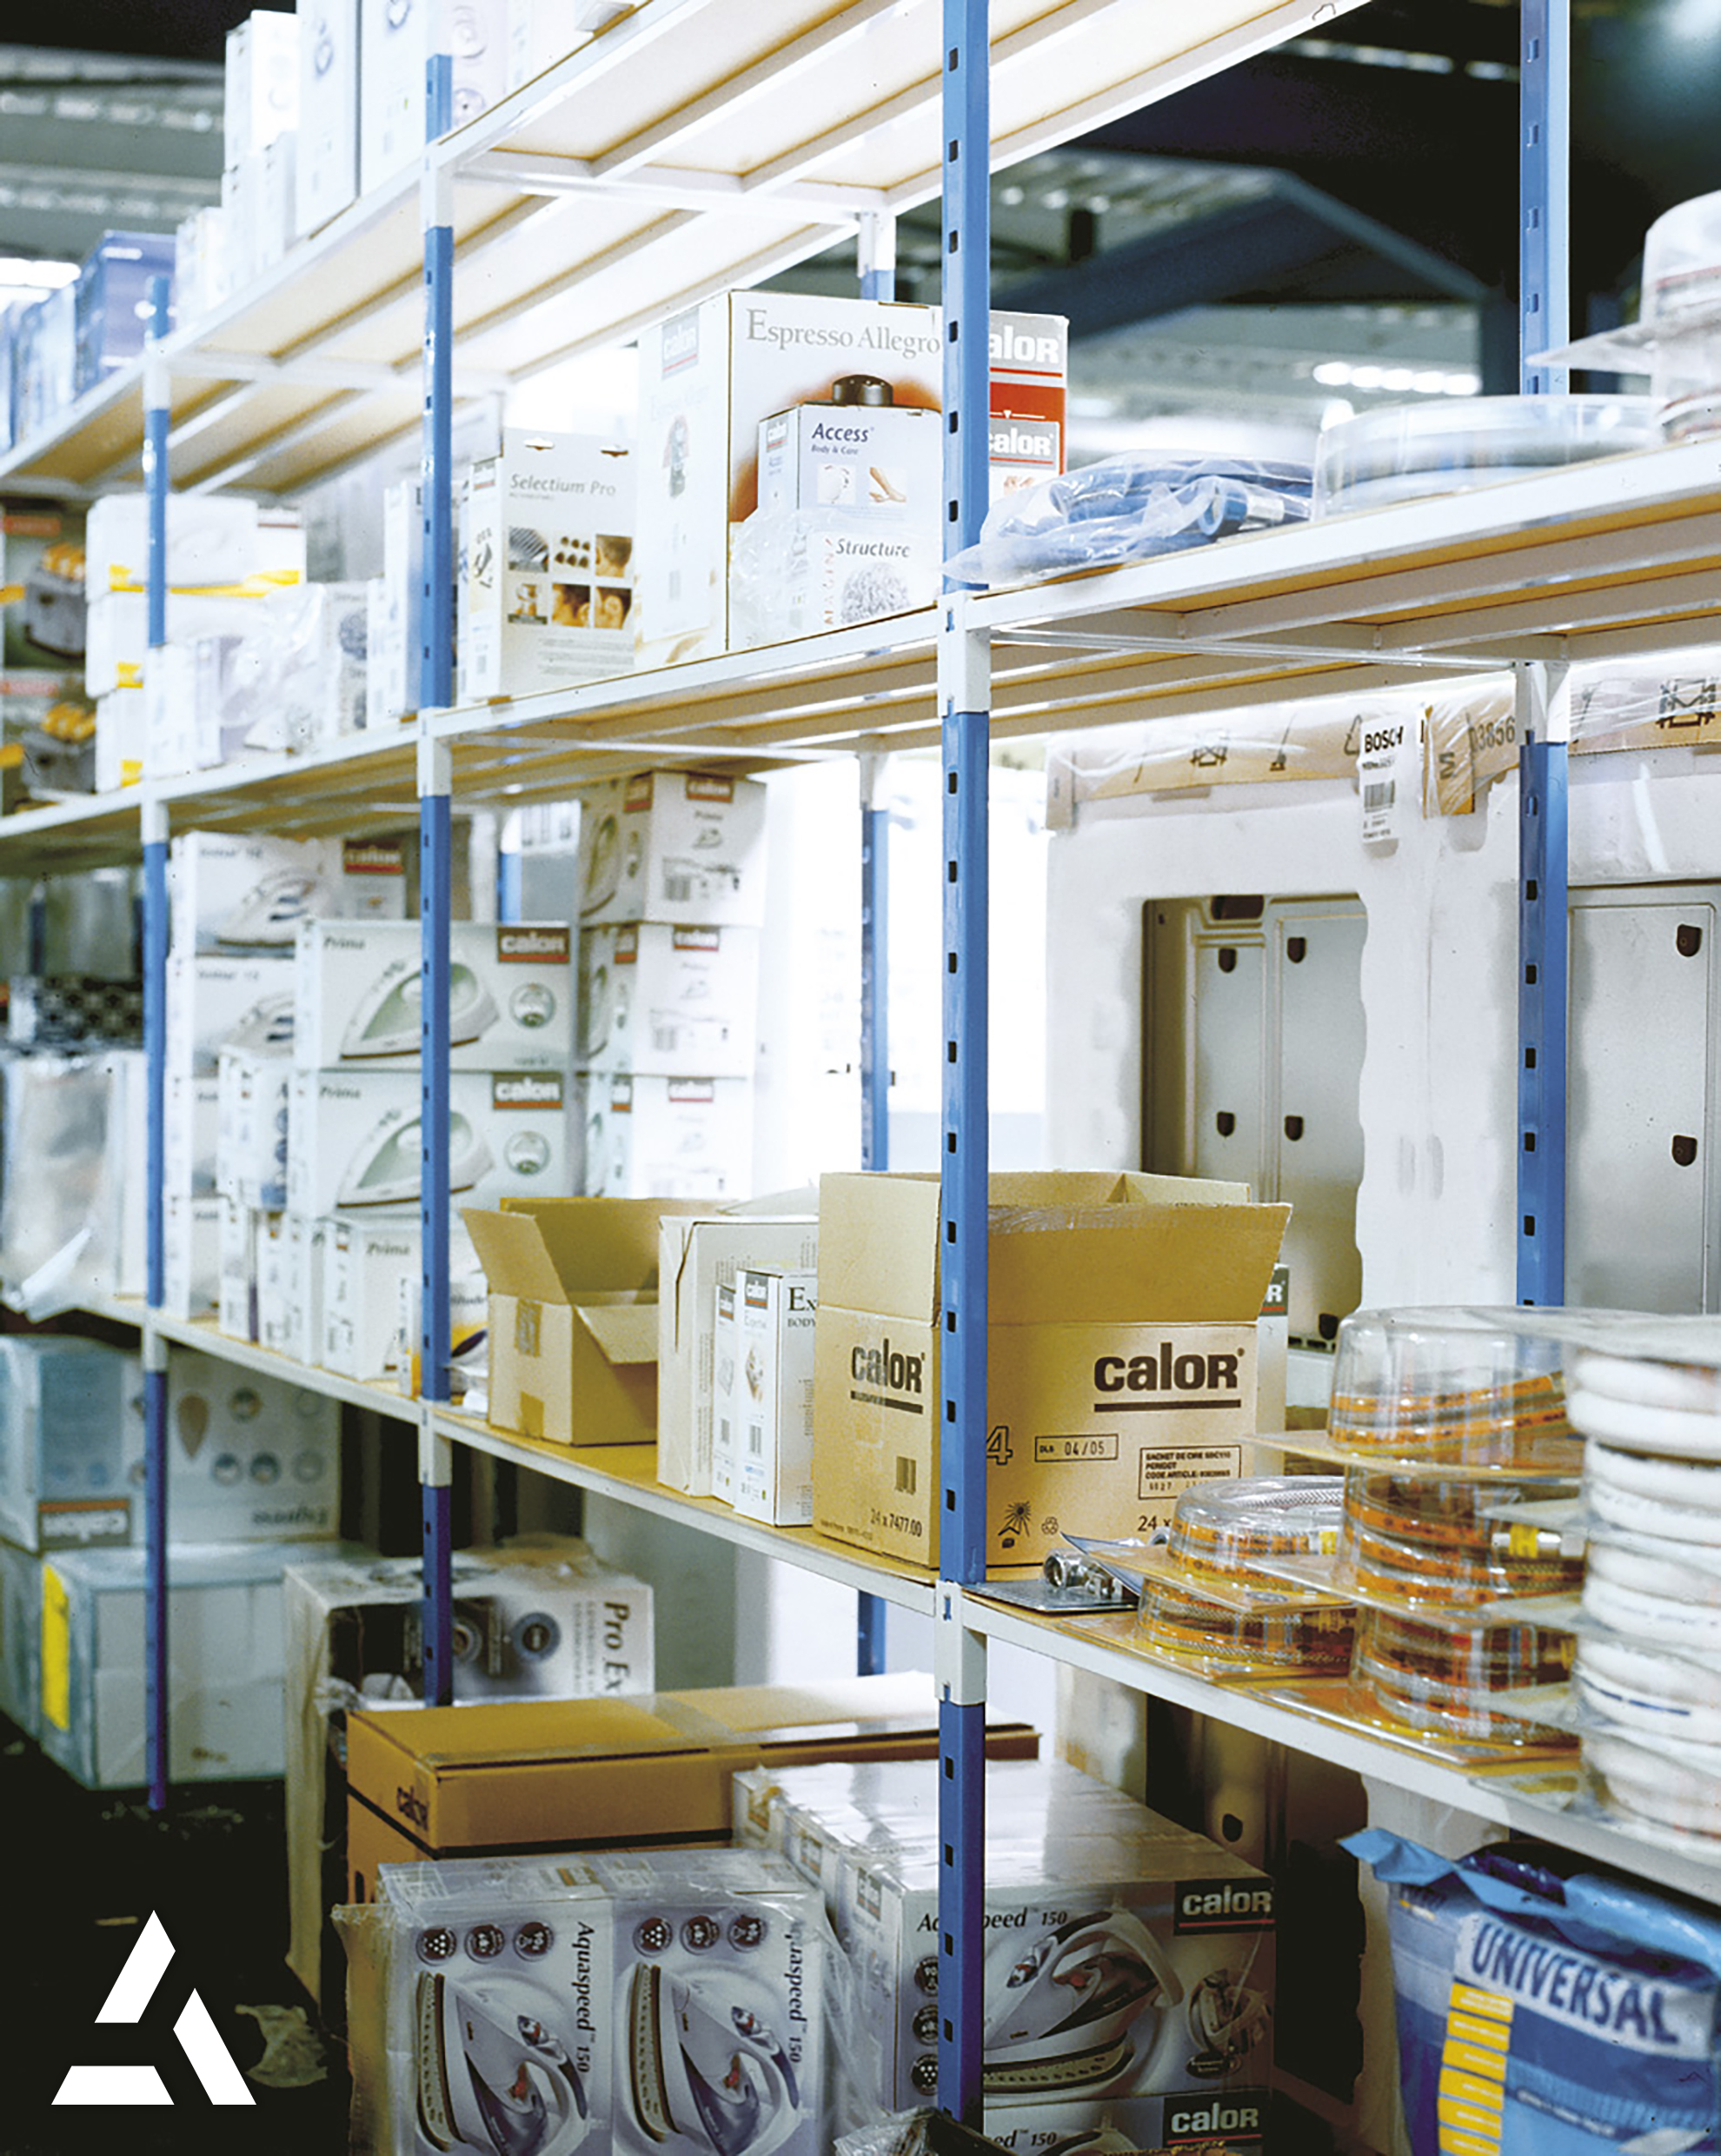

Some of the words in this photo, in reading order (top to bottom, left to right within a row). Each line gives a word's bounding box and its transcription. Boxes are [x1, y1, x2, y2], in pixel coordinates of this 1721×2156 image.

[747, 309, 853, 350] Espresso
[858, 327, 940, 358] Allegro
[812, 423, 869, 443] Access
[811, 444, 829, 454] Body
[510, 474, 585, 493] Selectium
[590, 481, 616, 496] Pro
[836, 539, 911, 558] Structure
[1365, 726, 1403, 753] BOSCH
[1065, 1441, 1105, 1456] 04/05
[1138, 1516, 1157, 1532] 24
[604, 1601, 631, 1650] Pro
[1041, 1911, 1068, 1926] 150
[1471, 1921, 1679, 2045] UNIVERSAL
[576, 2045, 591, 2073] 150
[788, 2036, 801, 2063] 150
[1031, 2132, 1057, 2147] 150
